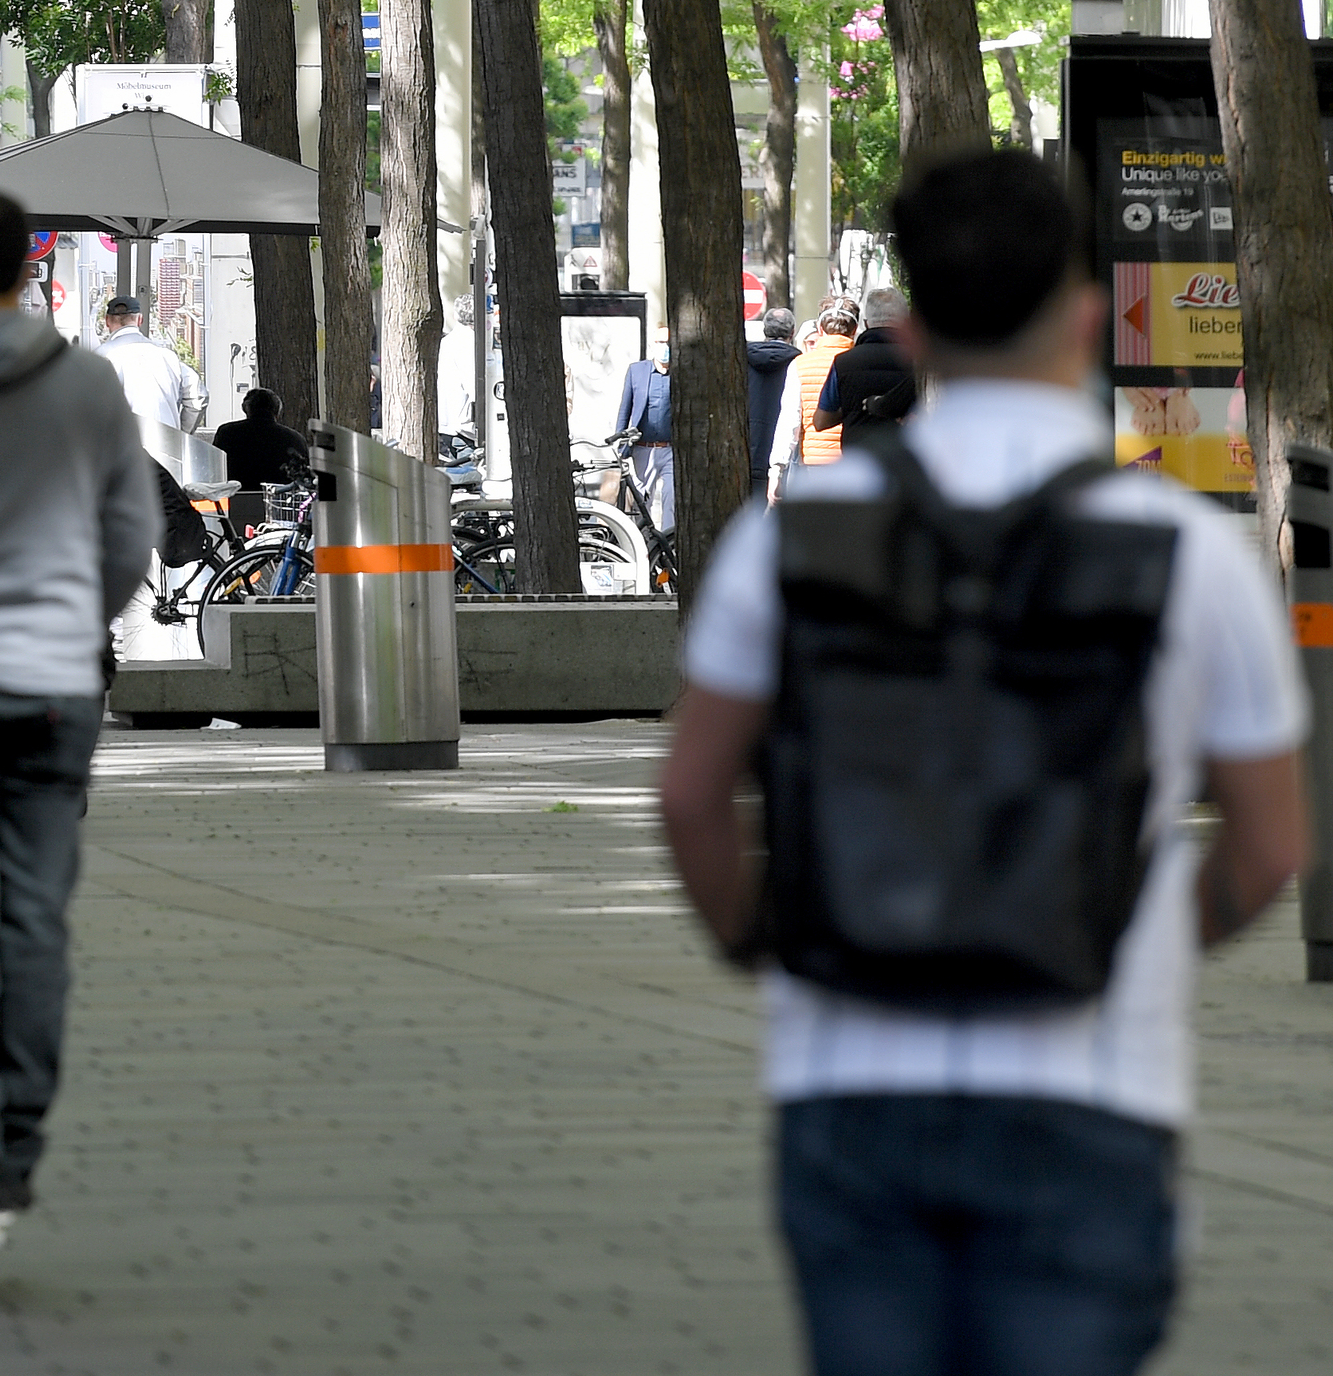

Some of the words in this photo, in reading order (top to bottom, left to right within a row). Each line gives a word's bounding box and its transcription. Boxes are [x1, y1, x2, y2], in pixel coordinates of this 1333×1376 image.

[1122, 150, 1206, 168] Einzigartig
[1121, 166, 1173, 183] Unique
[1175, 167, 1200, 180] like
